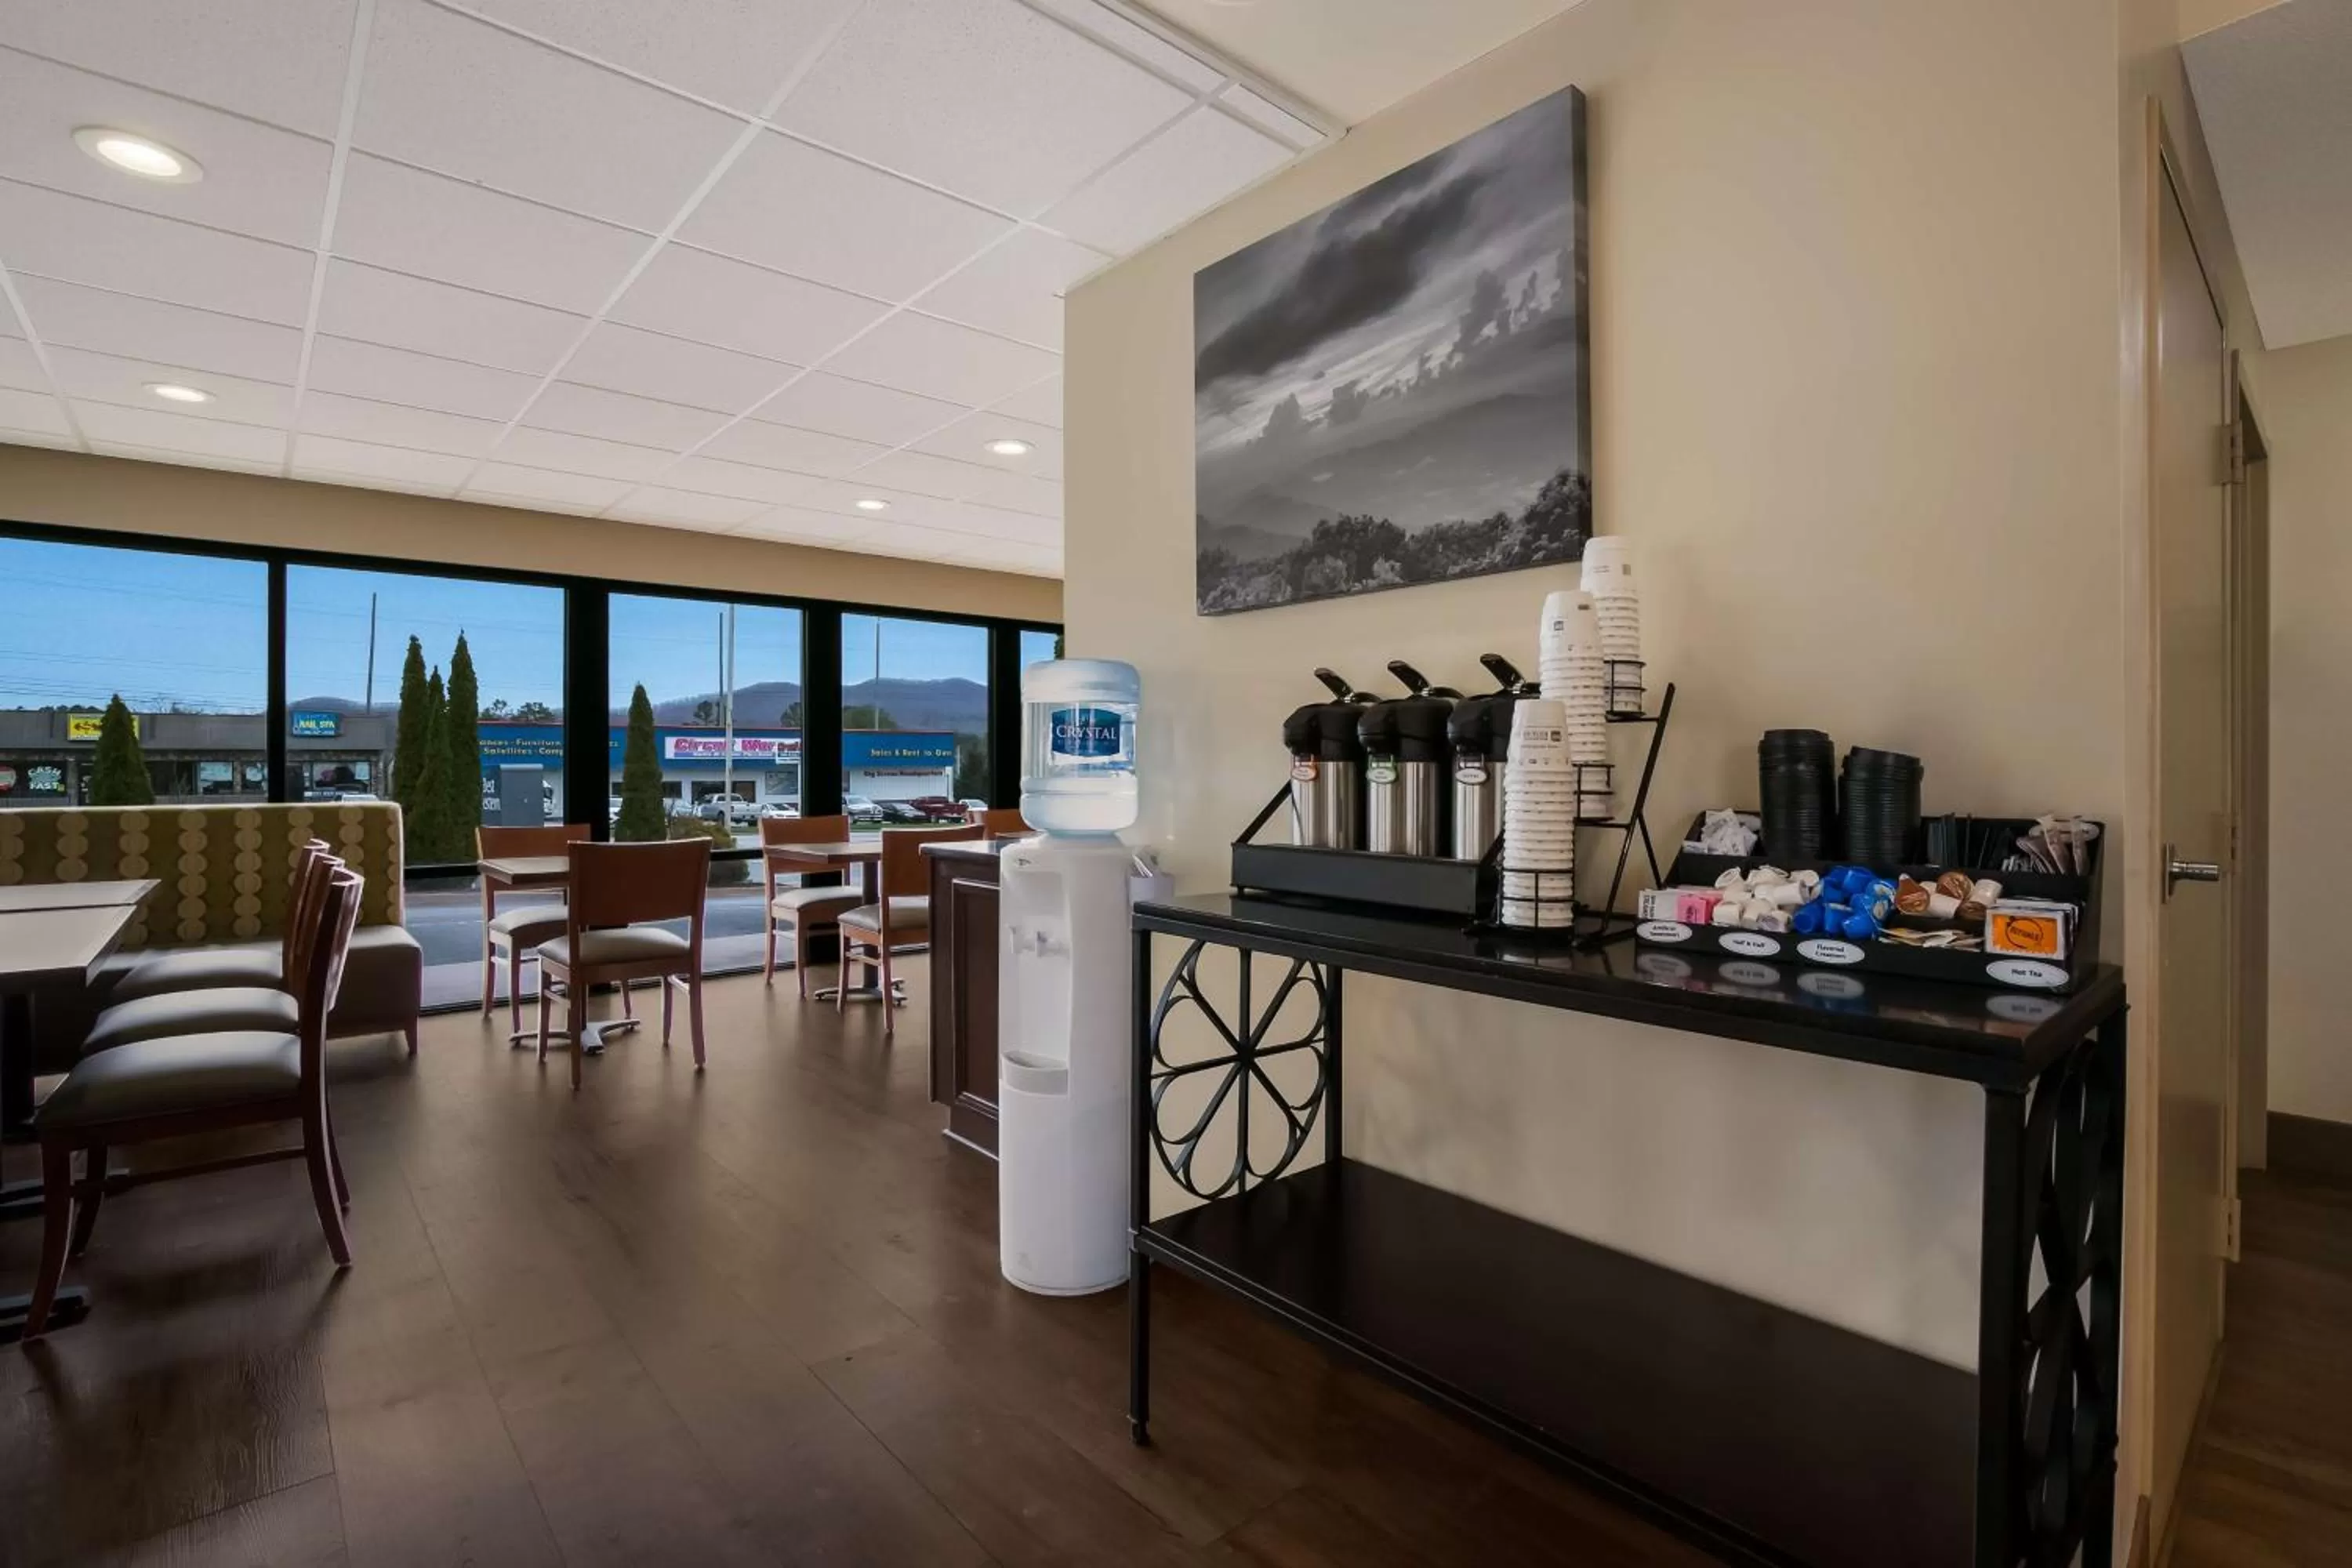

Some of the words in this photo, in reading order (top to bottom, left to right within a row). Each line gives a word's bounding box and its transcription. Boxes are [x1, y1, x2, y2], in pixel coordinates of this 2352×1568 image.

[299, 720, 315, 728] NAIL
[1056, 724, 1117, 739] CRYSTAL
[674, 738, 735, 752] Circui
[27, 766, 62, 776] CASH
[29, 782, 59, 790] FAST
